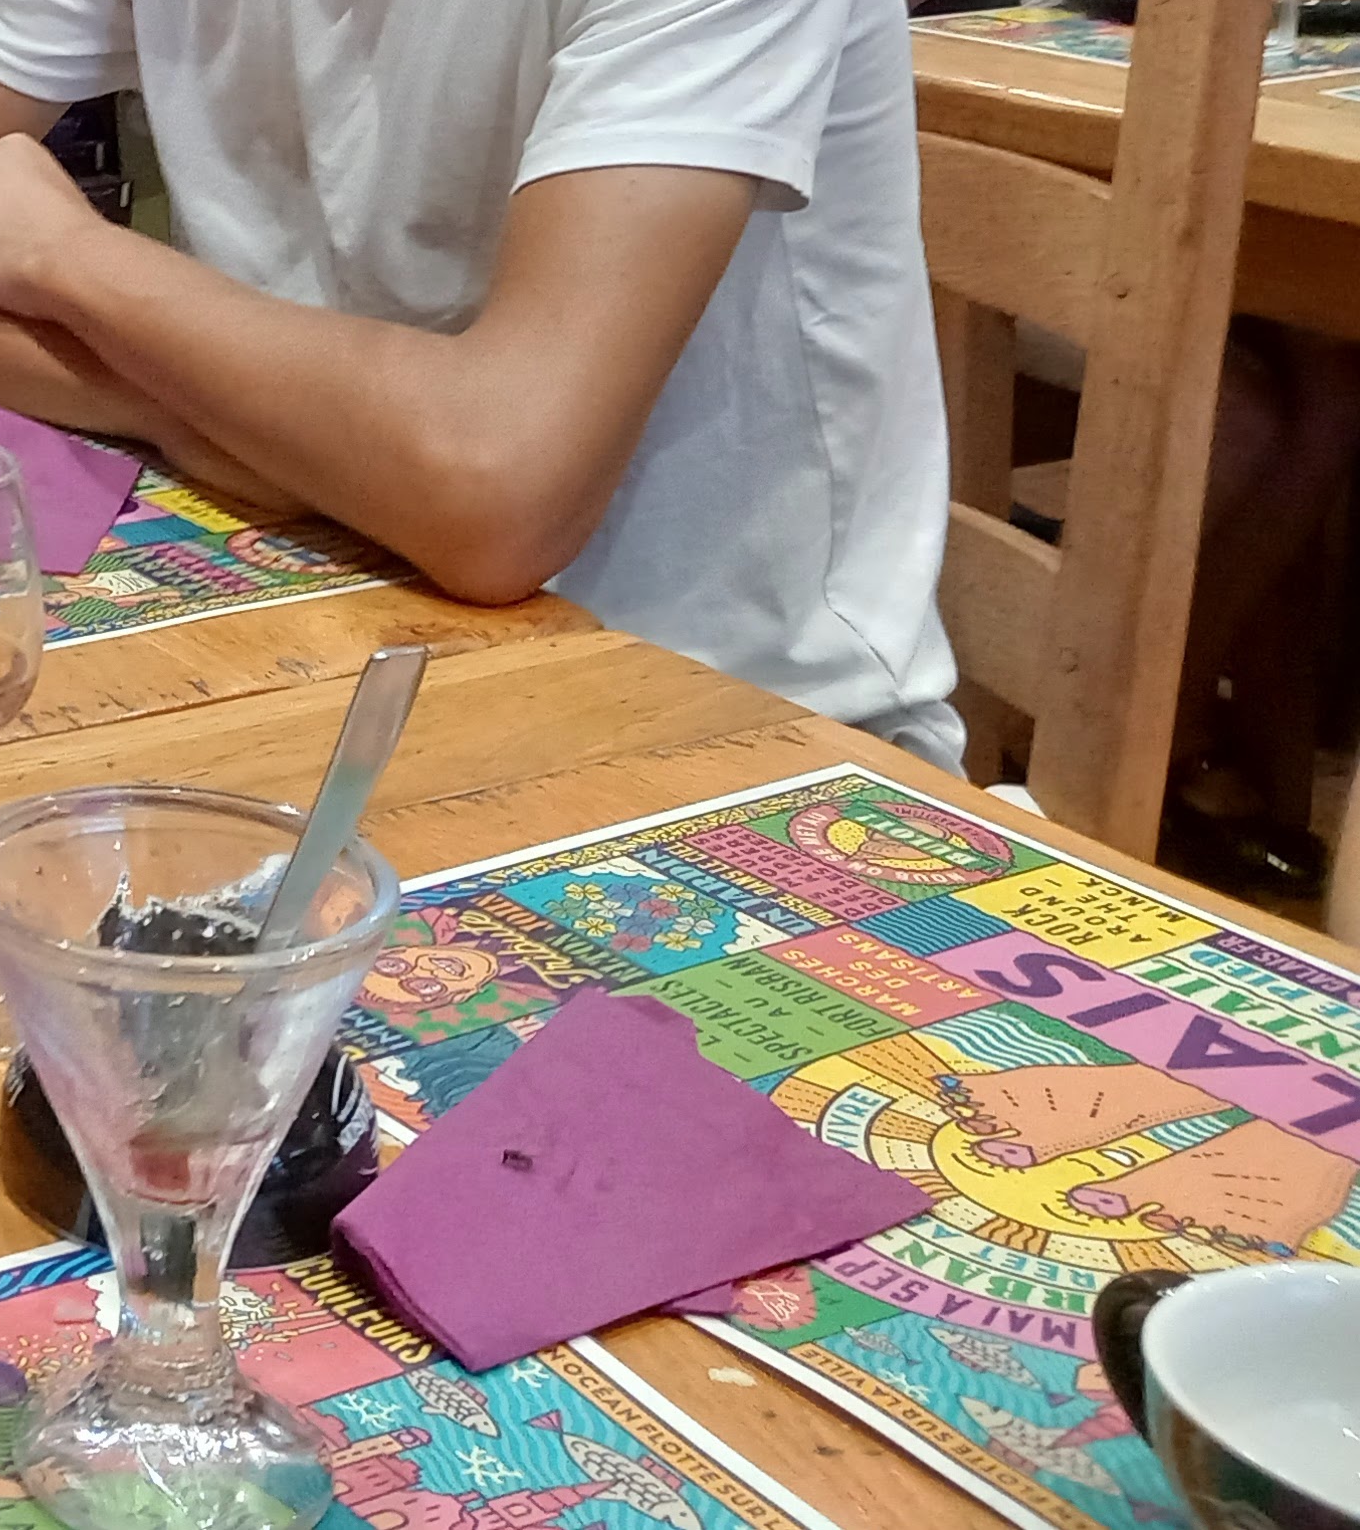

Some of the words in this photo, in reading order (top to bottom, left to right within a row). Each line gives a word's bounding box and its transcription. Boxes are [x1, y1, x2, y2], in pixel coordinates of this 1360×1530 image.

[665, 841, 708, 863] CIEL
[692, 837, 802, 889] MOULES
[705, 858, 728, 874] LE
[709, 832, 820, 884] KIPPERS
[812, 848, 844, 863] SE
[847, 861, 883, 876] ON
[634, 850, 767, 909] JARDIN
[725, 870, 777, 896] DANS
[813, 867, 860, 889] DES
[860, 888, 898, 906] OU
[895, 870, 967, 883] NOUS
[469, 893, 557, 933] JOHN
[776, 893, 844, 927] POUSSE
[808, 893, 864, 917] DES
[828, 887, 882, 912] DES
[1019, 886, 1152, 943] AROUND
[1076, 894, 1137, 923] THE
[1078, 878, 1186, 923] MINCK
[757, 906, 815, 936] UN
[1001, 903, 1102, 946] ROCK
[456, 909, 603, 989] Tribute
[836, 933, 982, 1000] ARTISANS
[720, 956, 828, 1005] RISBAN
[782, 949, 922, 1017] MARCHES
[848, 960, 910, 989] DES
[1189, 949, 1314, 1002] PIED
[649, 978, 814, 1061] SPECTACLES
[748, 997, 792, 1018] AU
[810, 1002, 890, 1039] FORT
[1132, 957, 1360, 1073] NTAIL
[973, 952, 1360, 1137] LAIS
[831, 1259, 932, 1304] SEP
[890, 1239, 1088, 1315] RBAN
[968, 1244, 1101, 1290] REET
[937, 1291, 975, 1321] À
[983, 1305, 1079, 1350] MAI
[799, 1348, 866, 1390] VILLE
[870, 1386, 904, 1409] LA
[562, 1362, 642, 1423] OCÉAN
[636, 1423, 721, 1485] FLOTTE
[716, 1481, 767, 1520] SUR
[902, 1408, 954, 1444] SUR
